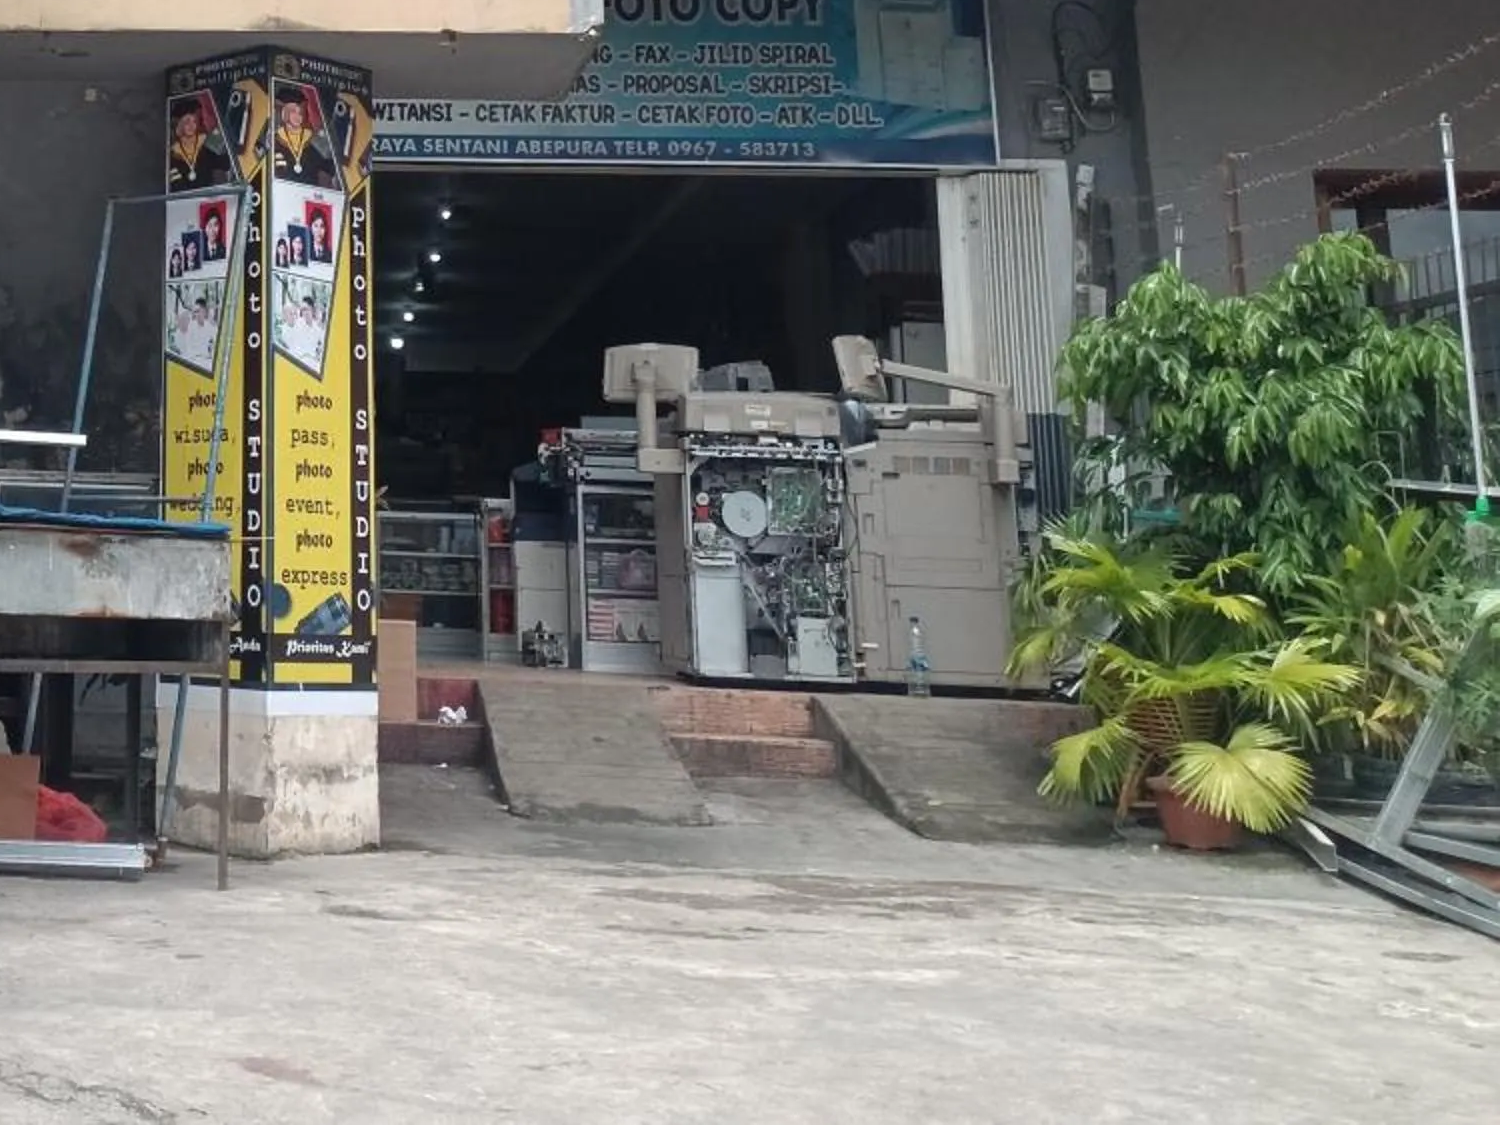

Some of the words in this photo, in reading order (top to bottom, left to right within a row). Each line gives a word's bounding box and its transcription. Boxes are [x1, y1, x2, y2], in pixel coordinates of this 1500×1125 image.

[635, 45, 671, 64] FAX
[693, 45, 751, 64] JILID
[759, 46, 834, 65] SPIRAL
[623, 75, 726, 94] PROPOSAL
[372, 102, 453, 122] WITANSI
[475, 104, 536, 123] CETAK
[542, 104, 615, 124] FAKTUR
[637, 105, 701, 124] CETAK
[706, 106, 752, 125] FOTO
[778, 106, 814, 125] ATK
[836, 106, 883, 125] DLL.
[422, 138, 508, 154] SENTANI
[514, 139, 608, 155] ABEPURA
[613, 140, 661, 156] TELP.
[668, 141, 717, 156] 0967
[739, 142, 816, 157] 583713
[351, 206, 367, 361] photo
[189, 391, 219, 413] phot
[295, 391, 333, 414] photo
[173, 425, 236, 444] wisua,
[187, 457, 225, 481] phoo
[295, 458, 333, 481] photo
[246, 398, 261, 607] STUDIO
[286, 498, 341, 520] event,
[355, 410, 371, 611] STUDIO
[295, 528, 333, 552] photo
[281, 568, 349, 590] express
